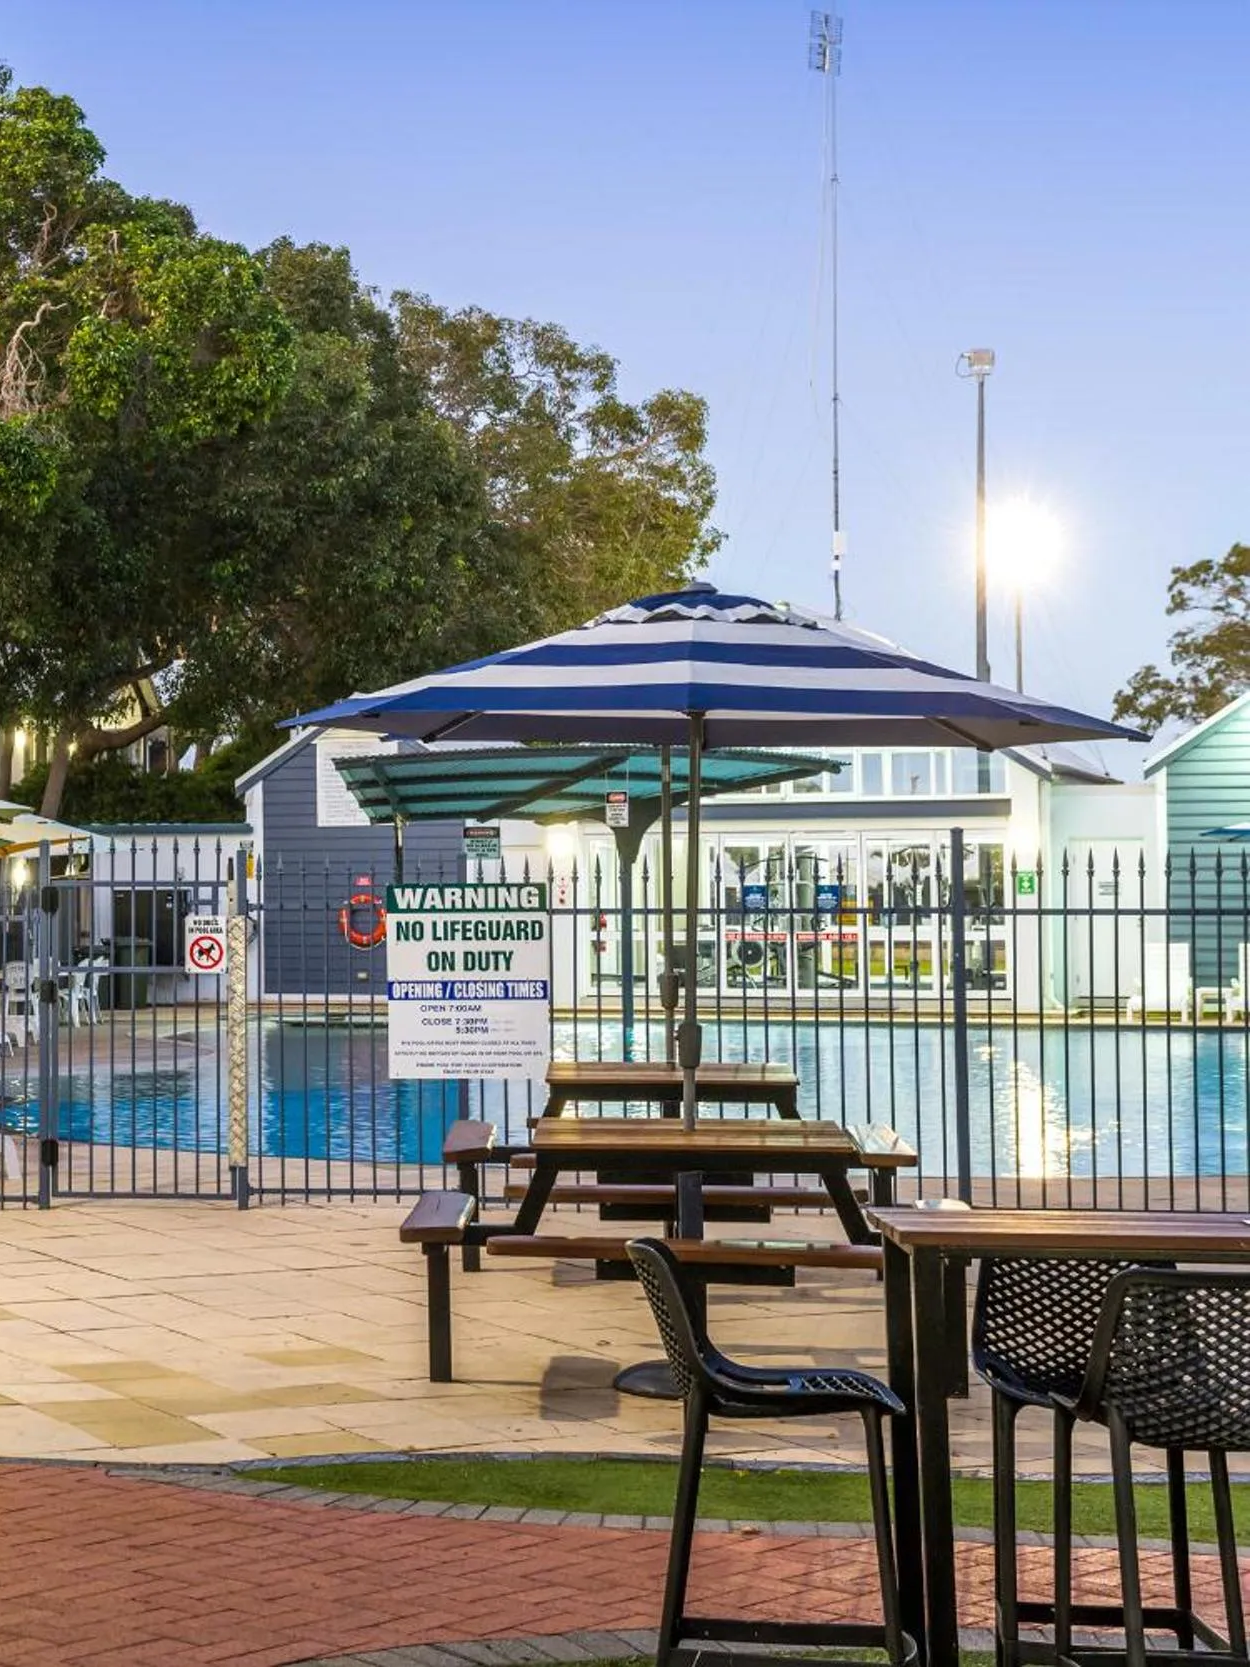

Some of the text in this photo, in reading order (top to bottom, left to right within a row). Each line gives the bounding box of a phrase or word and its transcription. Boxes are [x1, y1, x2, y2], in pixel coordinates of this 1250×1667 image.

[393, 886, 541, 910] WARNING
[396, 919, 544, 941] NO LIFEGUARD
[427, 950, 514, 972] ON DUTY
[392, 982, 443, 999] OPENING
[453, 982, 506, 998] CLOSING
[507, 981, 544, 998] TIMES
[419, 1004, 446, 1013] OPEN
[421, 1018, 452, 1026] CLOSE
